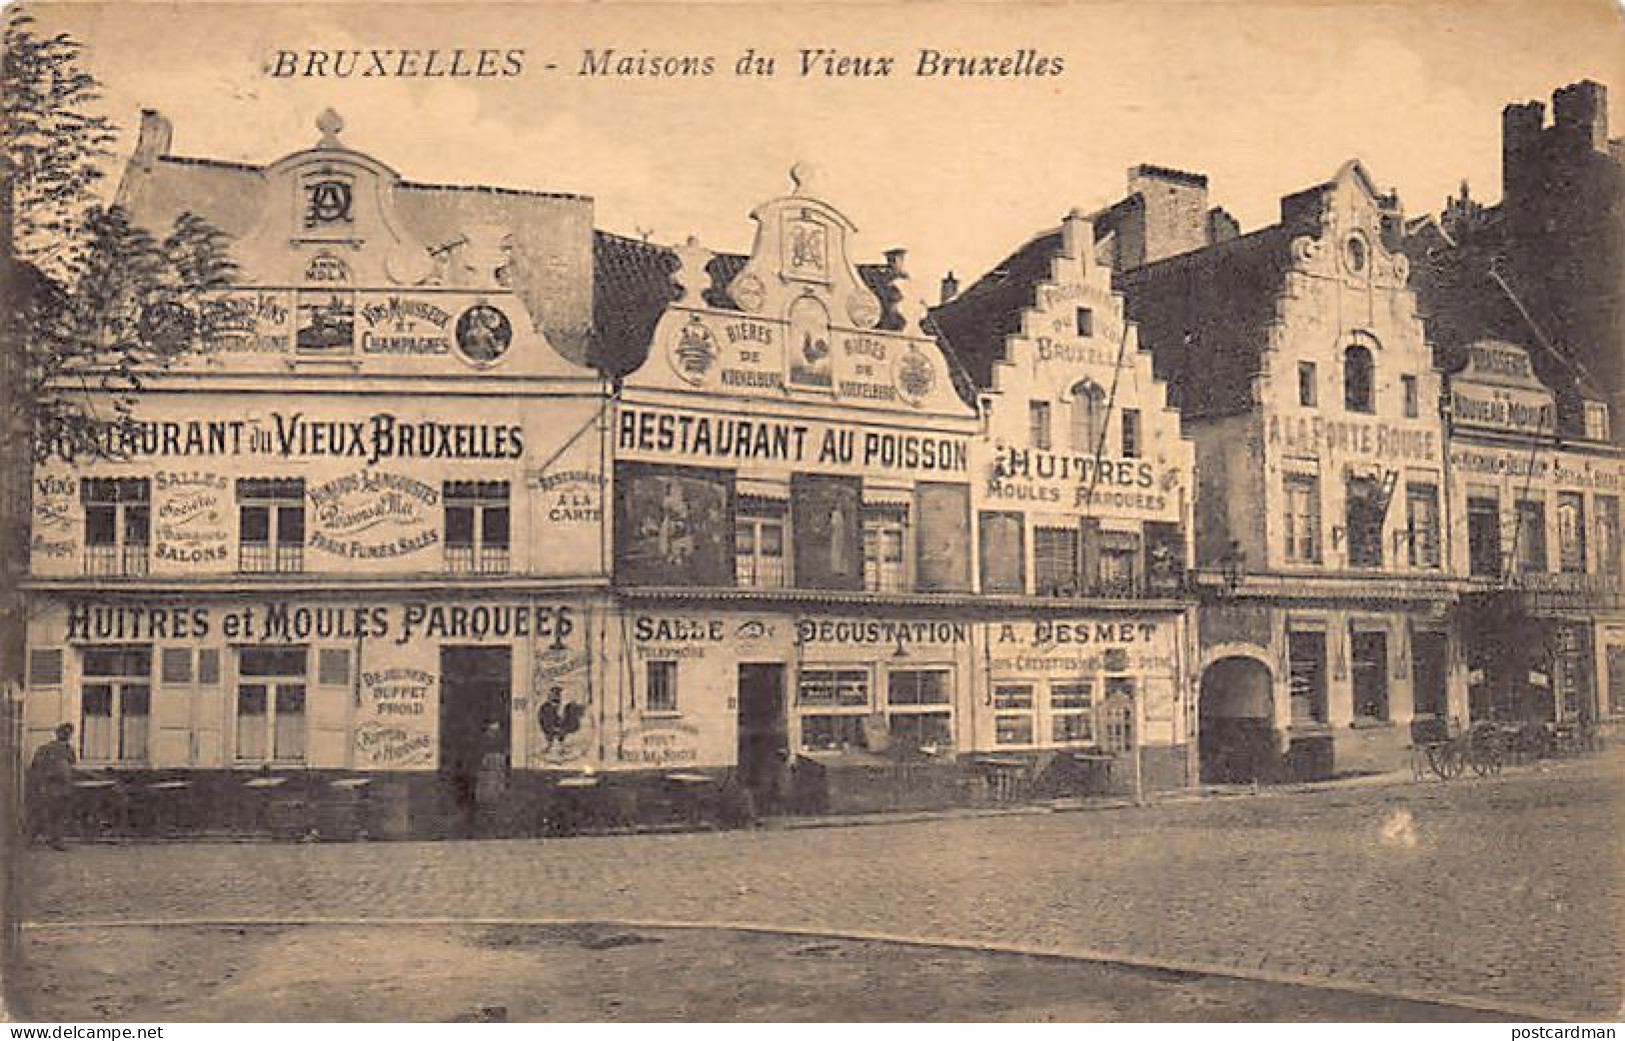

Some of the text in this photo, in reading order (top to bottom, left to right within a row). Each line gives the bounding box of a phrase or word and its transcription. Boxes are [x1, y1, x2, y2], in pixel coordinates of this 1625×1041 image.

[388, 297, 449, 329] MOUSSEUX
[362, 331, 449, 355] CHAMPAGNES
[727, 322, 772, 345] BIERES
[741, 352, 760, 362] DE
[1037, 337, 1132, 365] BRUXELLS
[272, 411, 367, 458] VIEUX
[367, 412, 524, 465] BRUXELLES
[619, 408, 966, 471] RESTAURANT AU POISSON
[155, 471, 228, 490] SALLES
[1003, 450, 1153, 487] HUITRES
[573, 494, 591, 506] LA
[987, 480, 1166, 511] MOULES PARQUEES
[549, 508, 602, 521] CARTE
[155, 543, 228, 562] SALONS
[65, 602, 574, 645] HUITRES et MOULES PARQUEES
[635, 617, 725, 642] SALLE
[793, 619, 966, 646] DEGUSTATION
[999, 622, 1156, 647] A. DESMET
[373, 687, 428, 699] BUFFET
[377, 702, 424, 716] FROID
